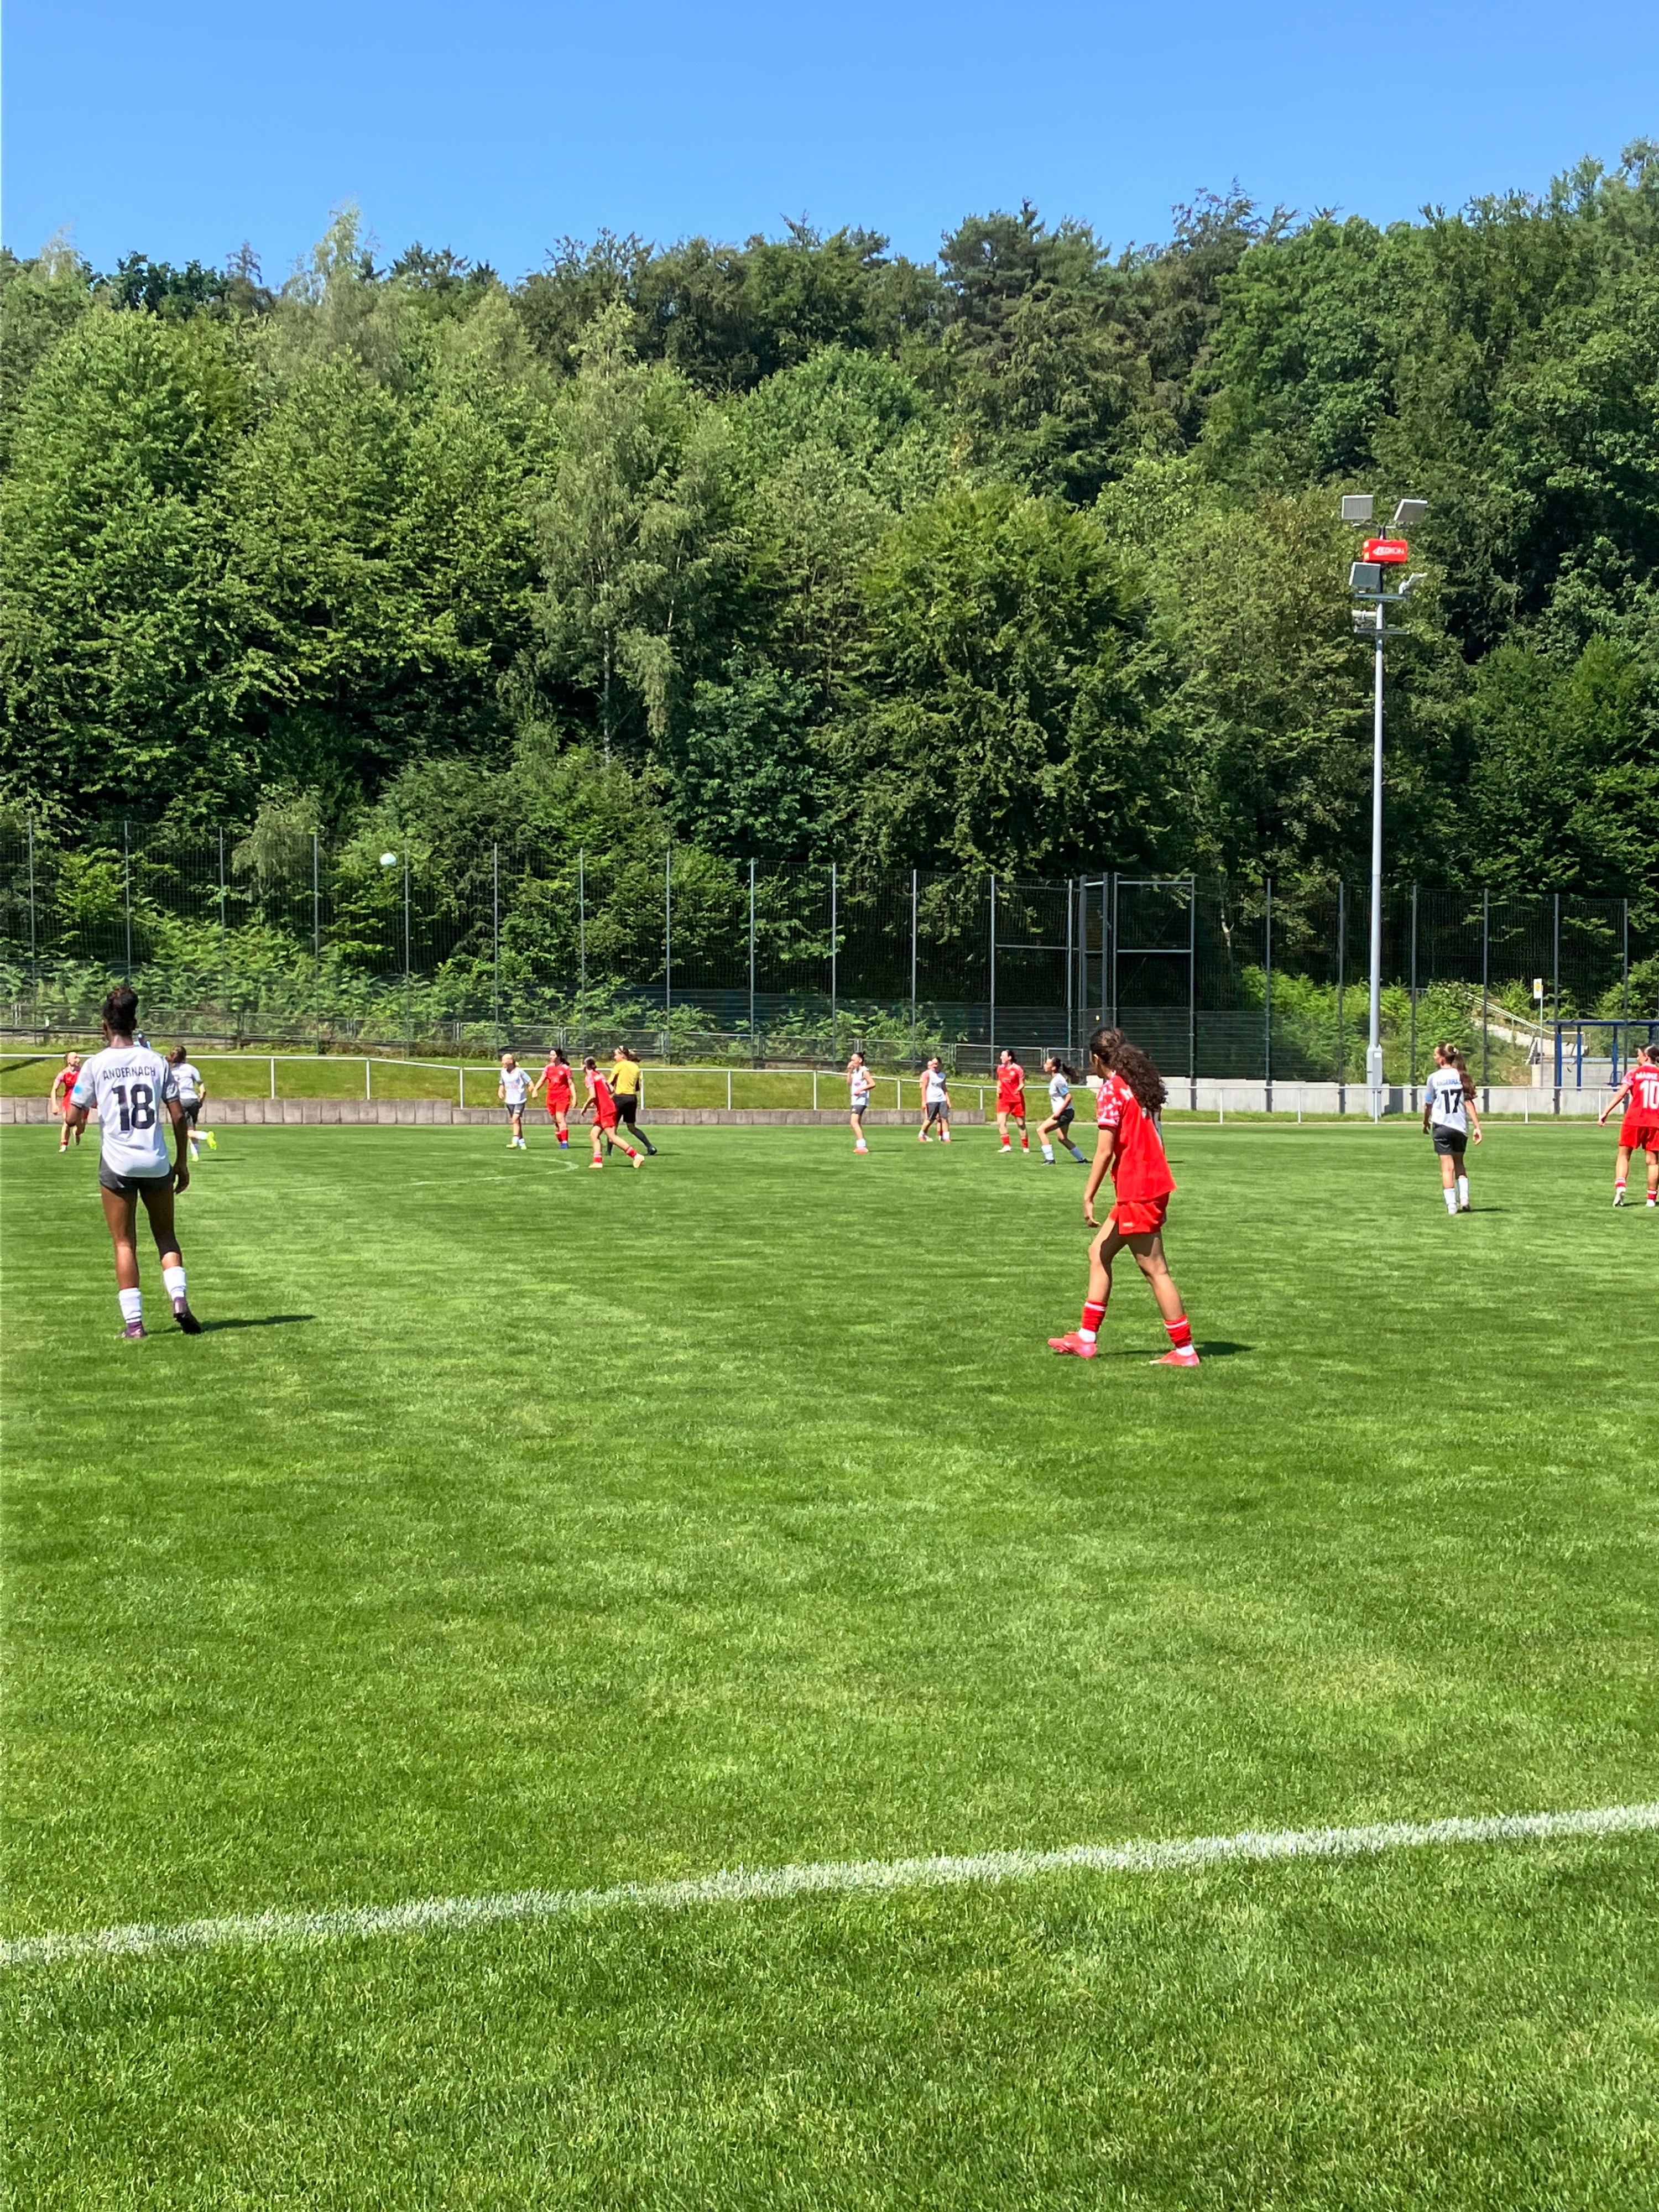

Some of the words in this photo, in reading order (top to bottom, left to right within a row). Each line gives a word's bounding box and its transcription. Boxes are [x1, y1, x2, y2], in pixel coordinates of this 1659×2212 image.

[103, 1066, 156, 1080] ANDERNACH
[1635, 1071, 1658, 1080] MAINZ
[1441, 1089, 1462, 1114] 17
[1640, 1079, 1659, 1109] 10
[112, 1083, 155, 1131] 18
